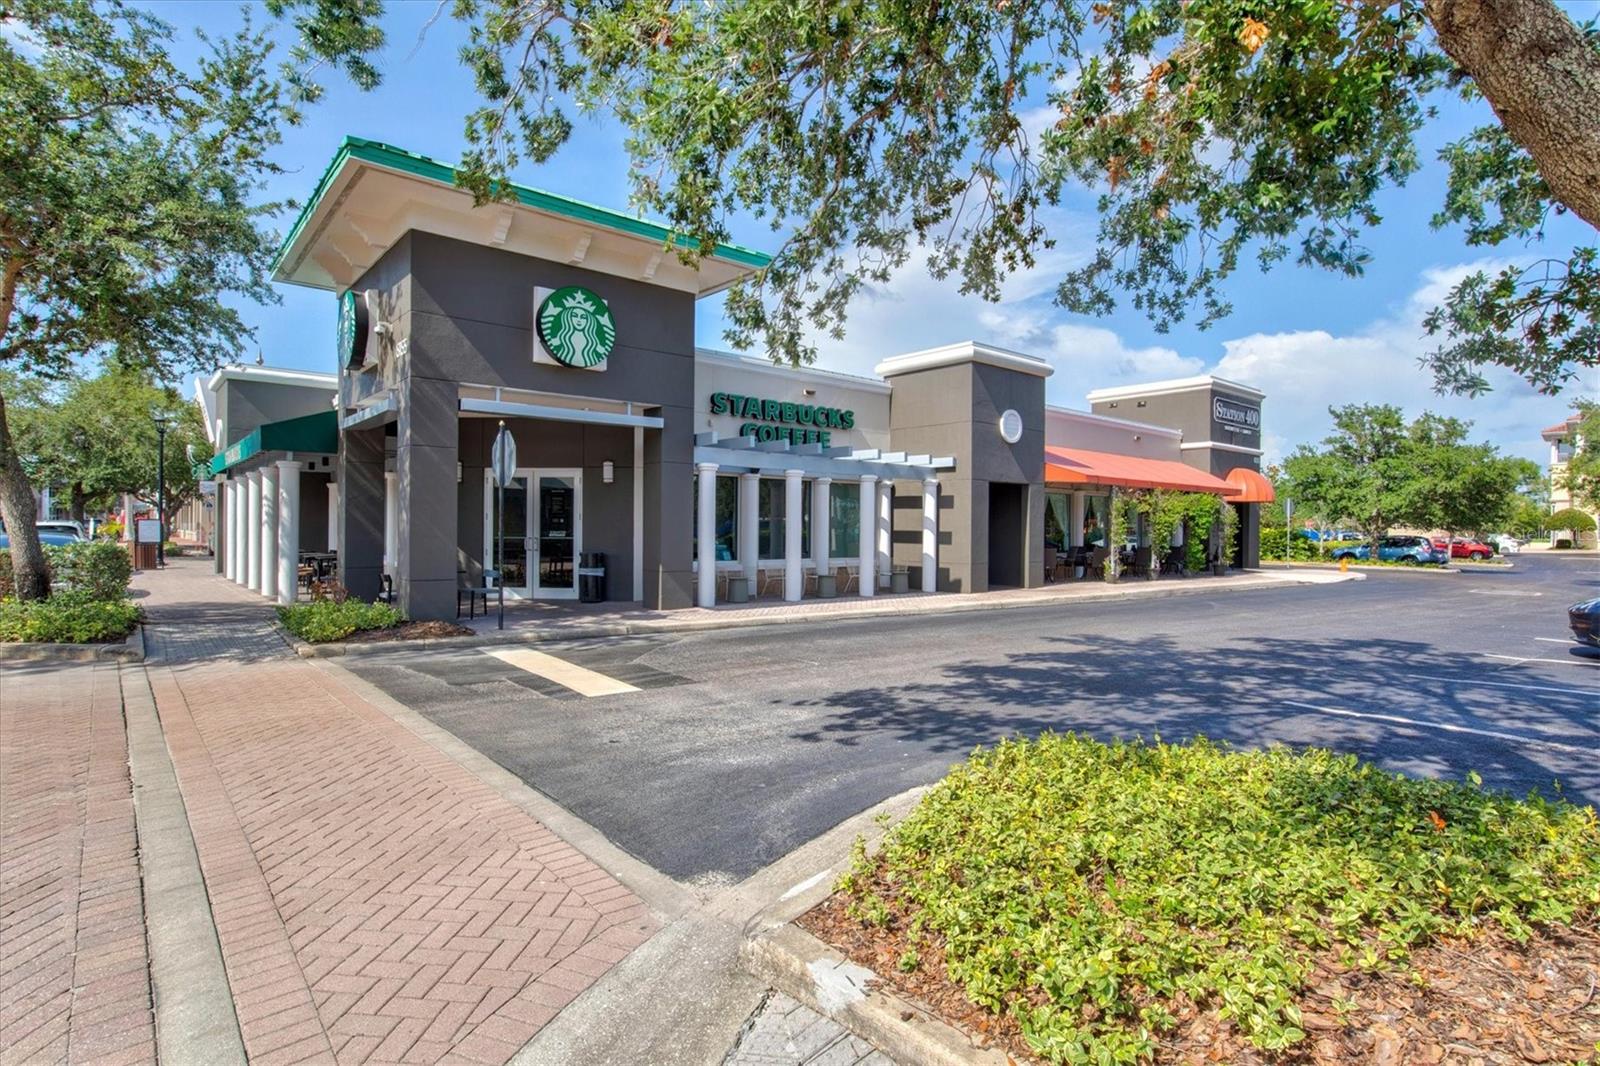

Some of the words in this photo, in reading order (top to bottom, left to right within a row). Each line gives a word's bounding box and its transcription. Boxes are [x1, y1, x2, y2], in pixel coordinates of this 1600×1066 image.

[711, 392, 854, 429] STARBUCKS
[1246, 409, 1259, 426] 400
[740, 423, 831, 448] COFFEE
